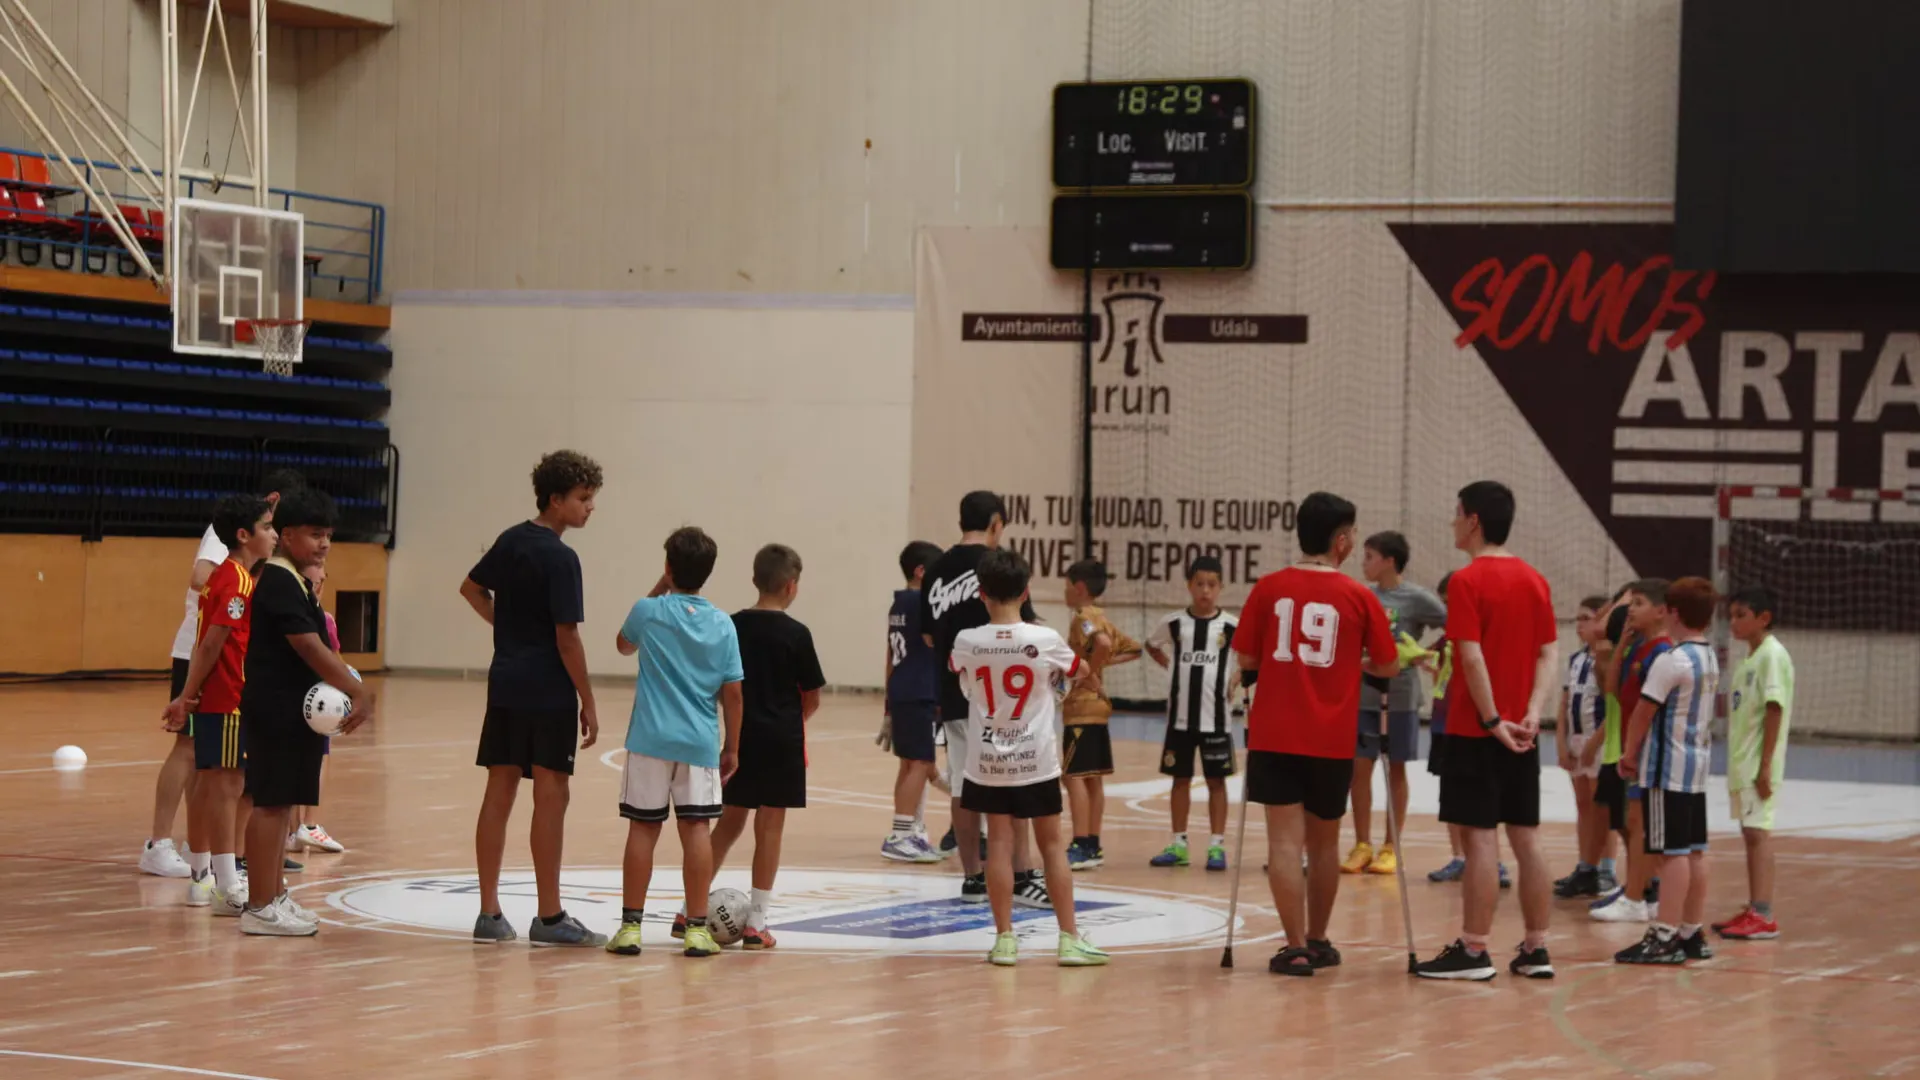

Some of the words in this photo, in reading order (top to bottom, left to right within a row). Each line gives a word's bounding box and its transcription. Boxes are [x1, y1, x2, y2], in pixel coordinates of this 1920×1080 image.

[1117, 85, 1204, 114] 18:29
[1210, 319, 1260, 338] Udala
[1451, 250, 1717, 353] SOMOS
[1617, 331, 1920, 422] ARTA
[1045, 494, 1072, 527] TU
[1176, 497, 1205, 530] TU
[1272, 597, 1340, 669] 19
[974, 664, 1035, 721] 19
